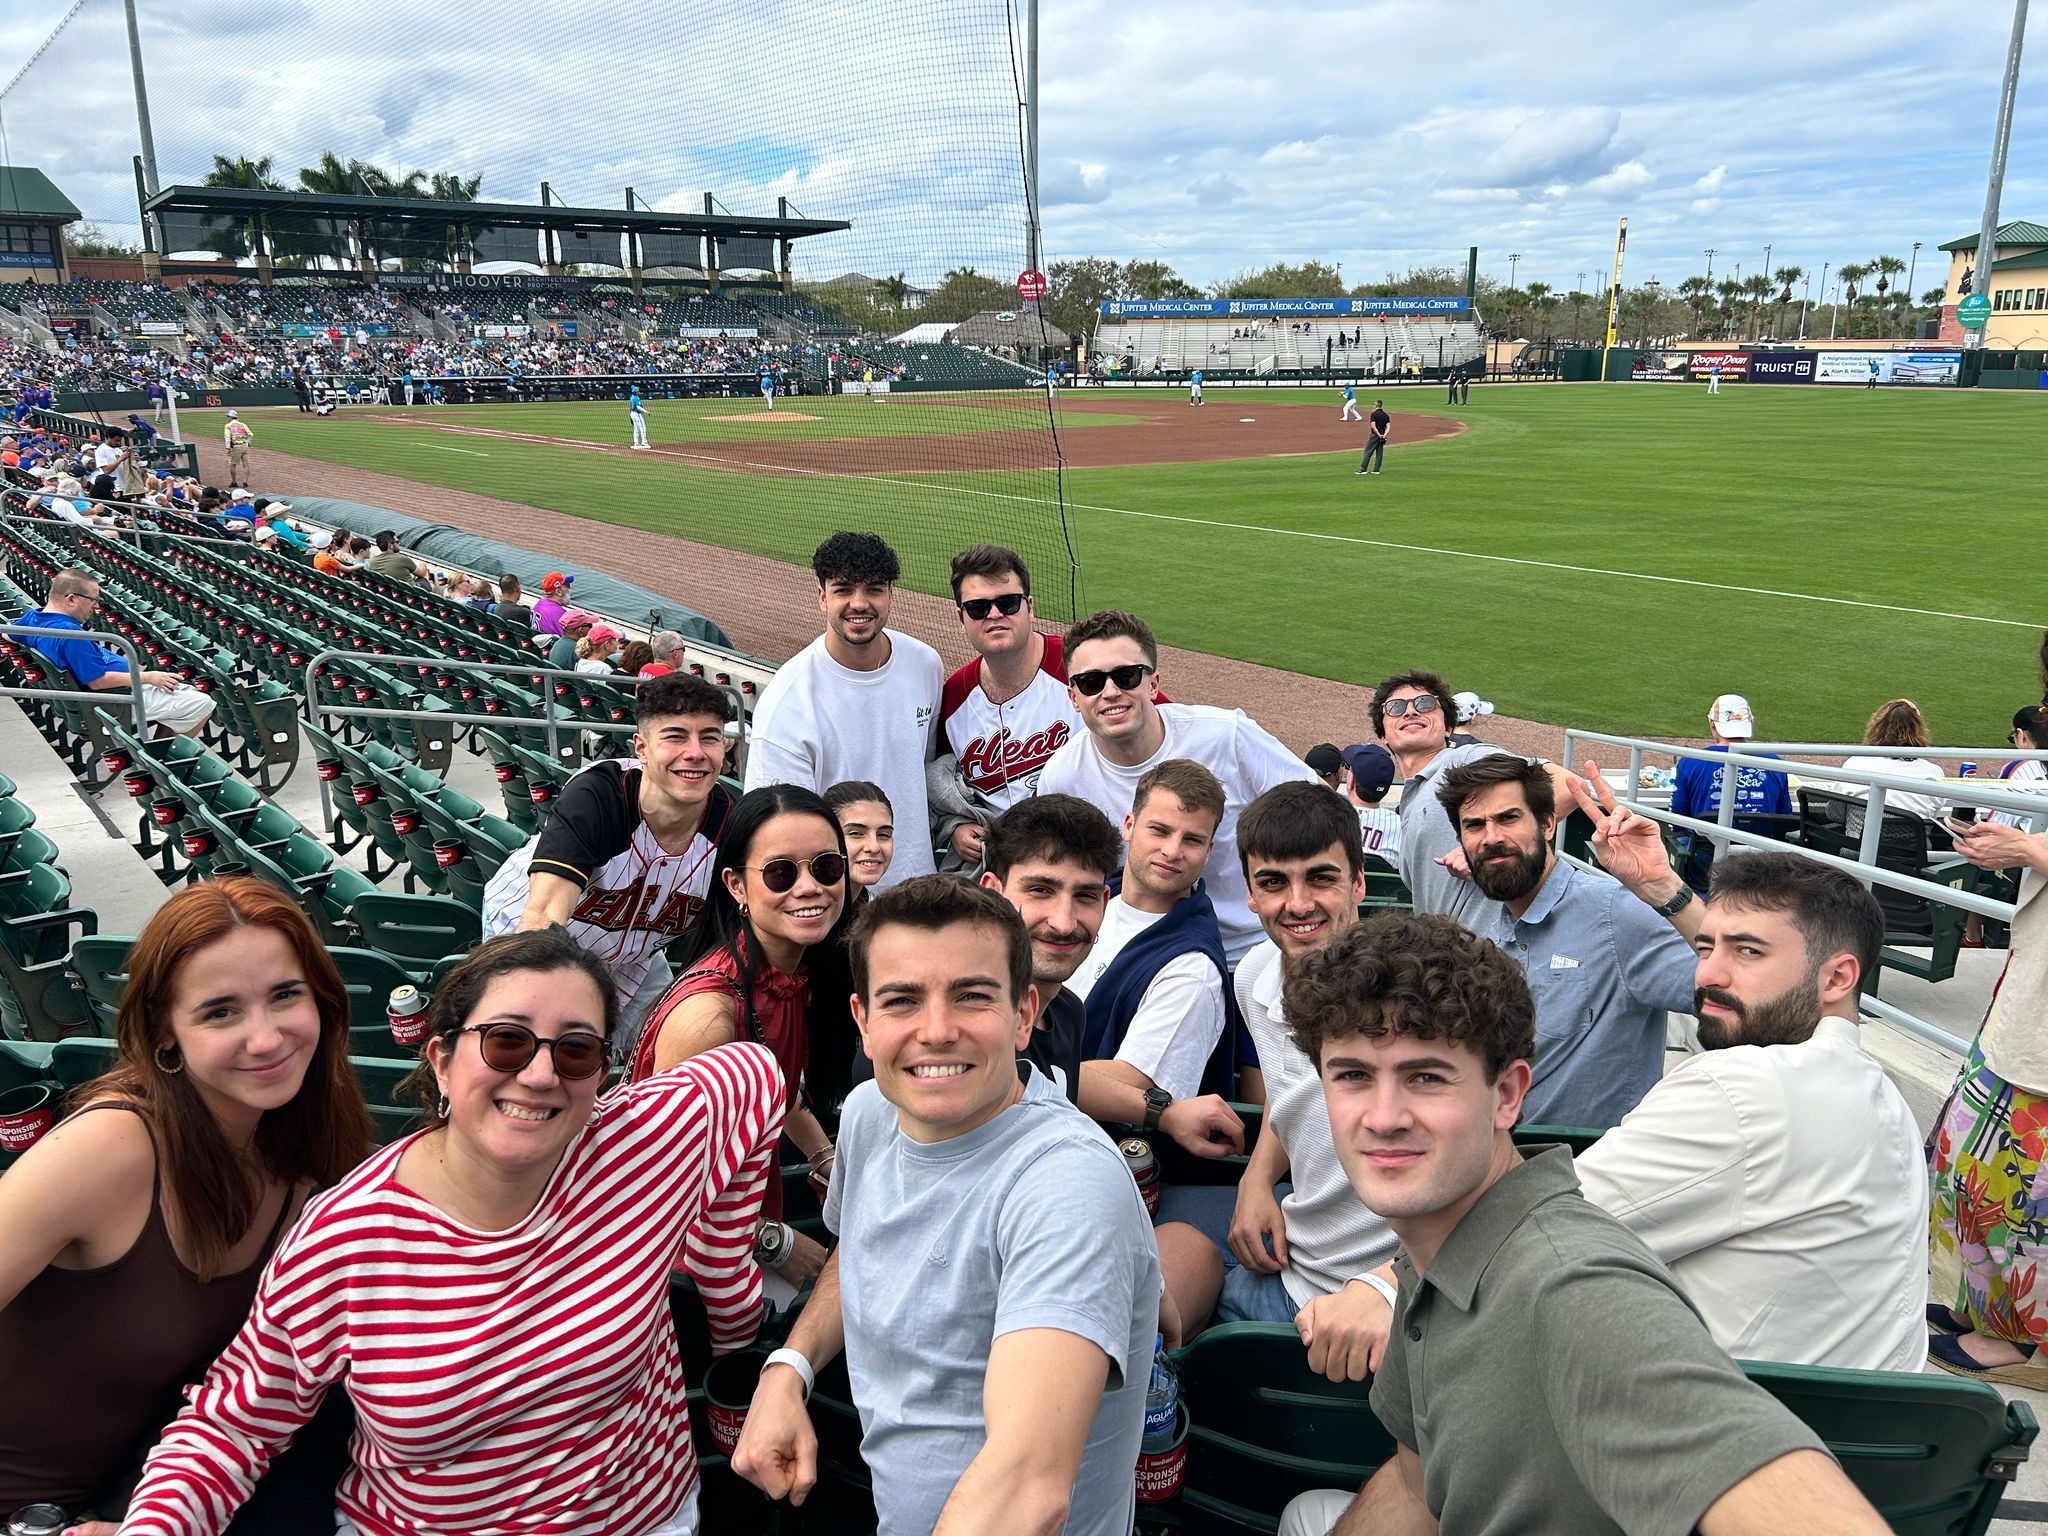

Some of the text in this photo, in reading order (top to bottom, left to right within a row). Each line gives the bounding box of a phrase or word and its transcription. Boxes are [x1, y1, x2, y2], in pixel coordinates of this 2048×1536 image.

[453, 275, 522, 288] HOOVER
[1121, 302, 1212, 312] JUPITER MEDICAL CENTER
[1241, 301, 1334, 311] JUPITER MEDICAL CENTER
[1363, 300, 1458, 311] JUPITER MEDICAL CENTER
[1691, 354, 1748, 366] Roger Dean
[1754, 363, 1795, 373] TRUIST
[961, 719, 1070, 780] Heat
[1362, 826, 1383, 851] TO
[571, 876, 704, 934] HEA
[9, 1131, 35, 1142] WISER
[1147, 1474, 1178, 1491] WISER
